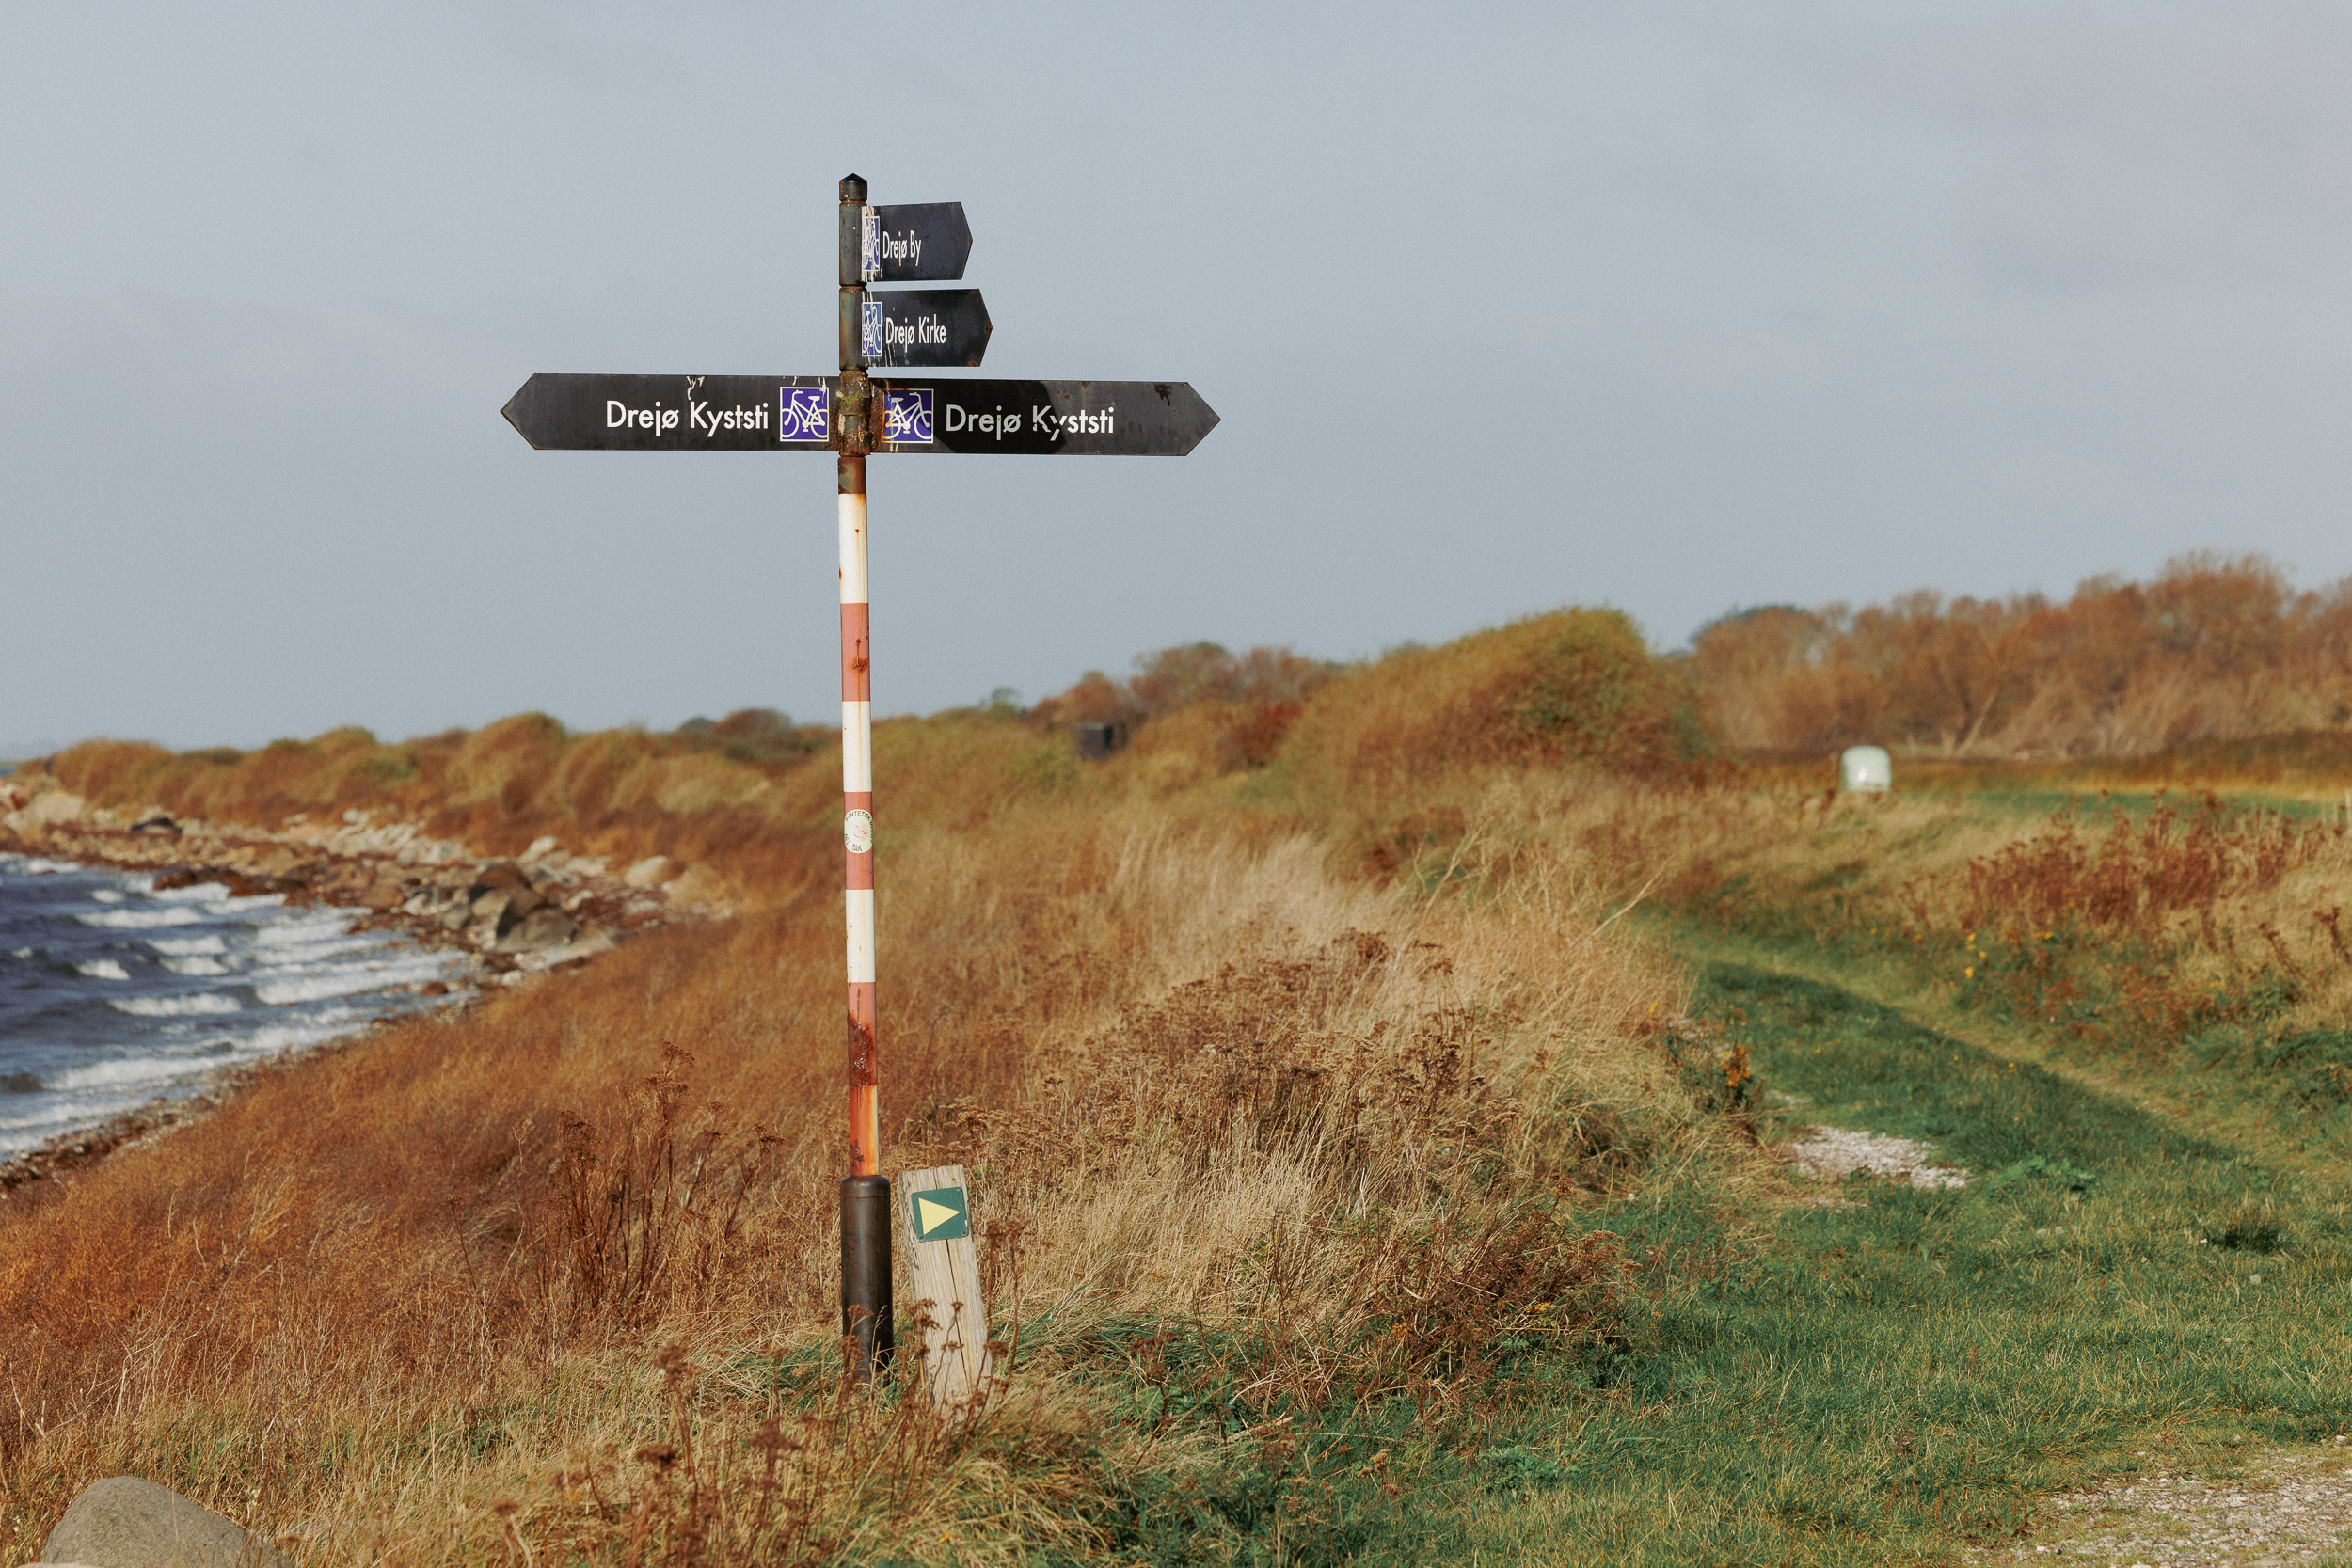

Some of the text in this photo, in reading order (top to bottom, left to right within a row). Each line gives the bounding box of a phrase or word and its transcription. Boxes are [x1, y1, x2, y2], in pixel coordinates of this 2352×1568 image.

[883, 230, 922, 267] Drejø By
[885, 314, 946, 353] Drejø Kirke
[606, 400, 769, 437] Drejø Kyststi
[946, 404, 1114, 442] Drejø Kyststi
[851, 844, 863, 852] TAK
